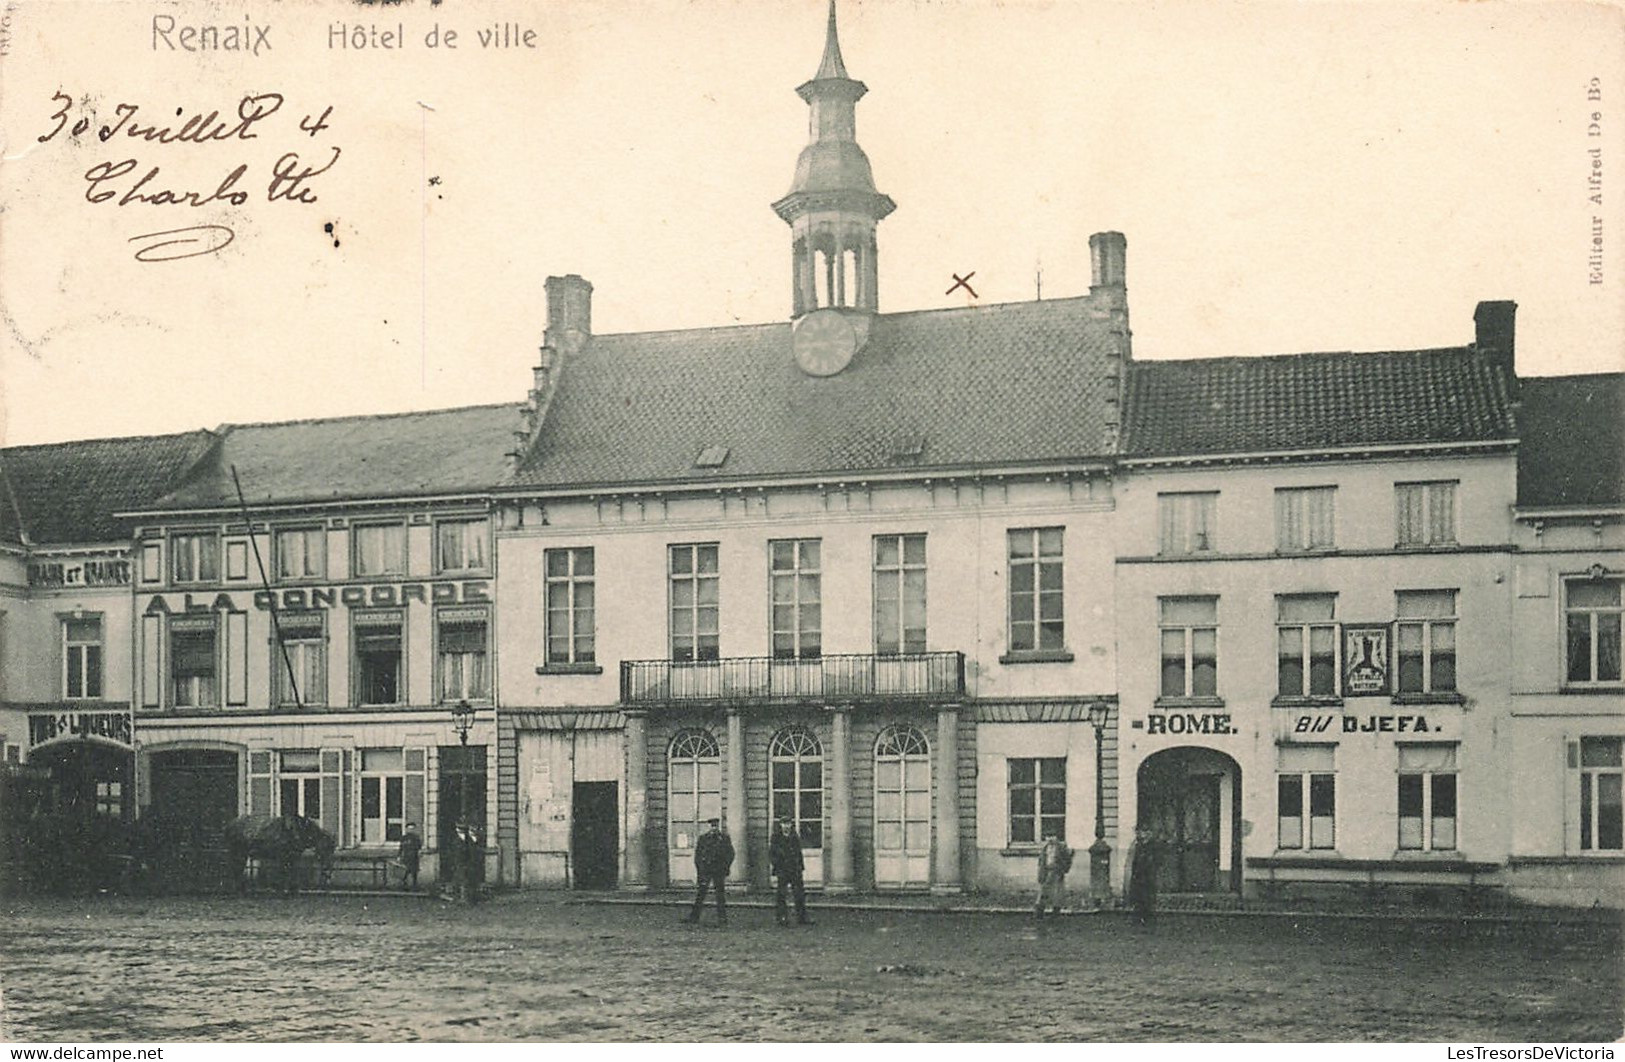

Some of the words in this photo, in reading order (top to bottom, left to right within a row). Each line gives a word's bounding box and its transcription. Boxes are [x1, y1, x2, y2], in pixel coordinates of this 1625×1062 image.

[300, 105, 333, 136] 4
[146, 594, 171, 614] A
[184, 593, 238, 614] LA
[253, 581, 490, 612] CONCORDE
